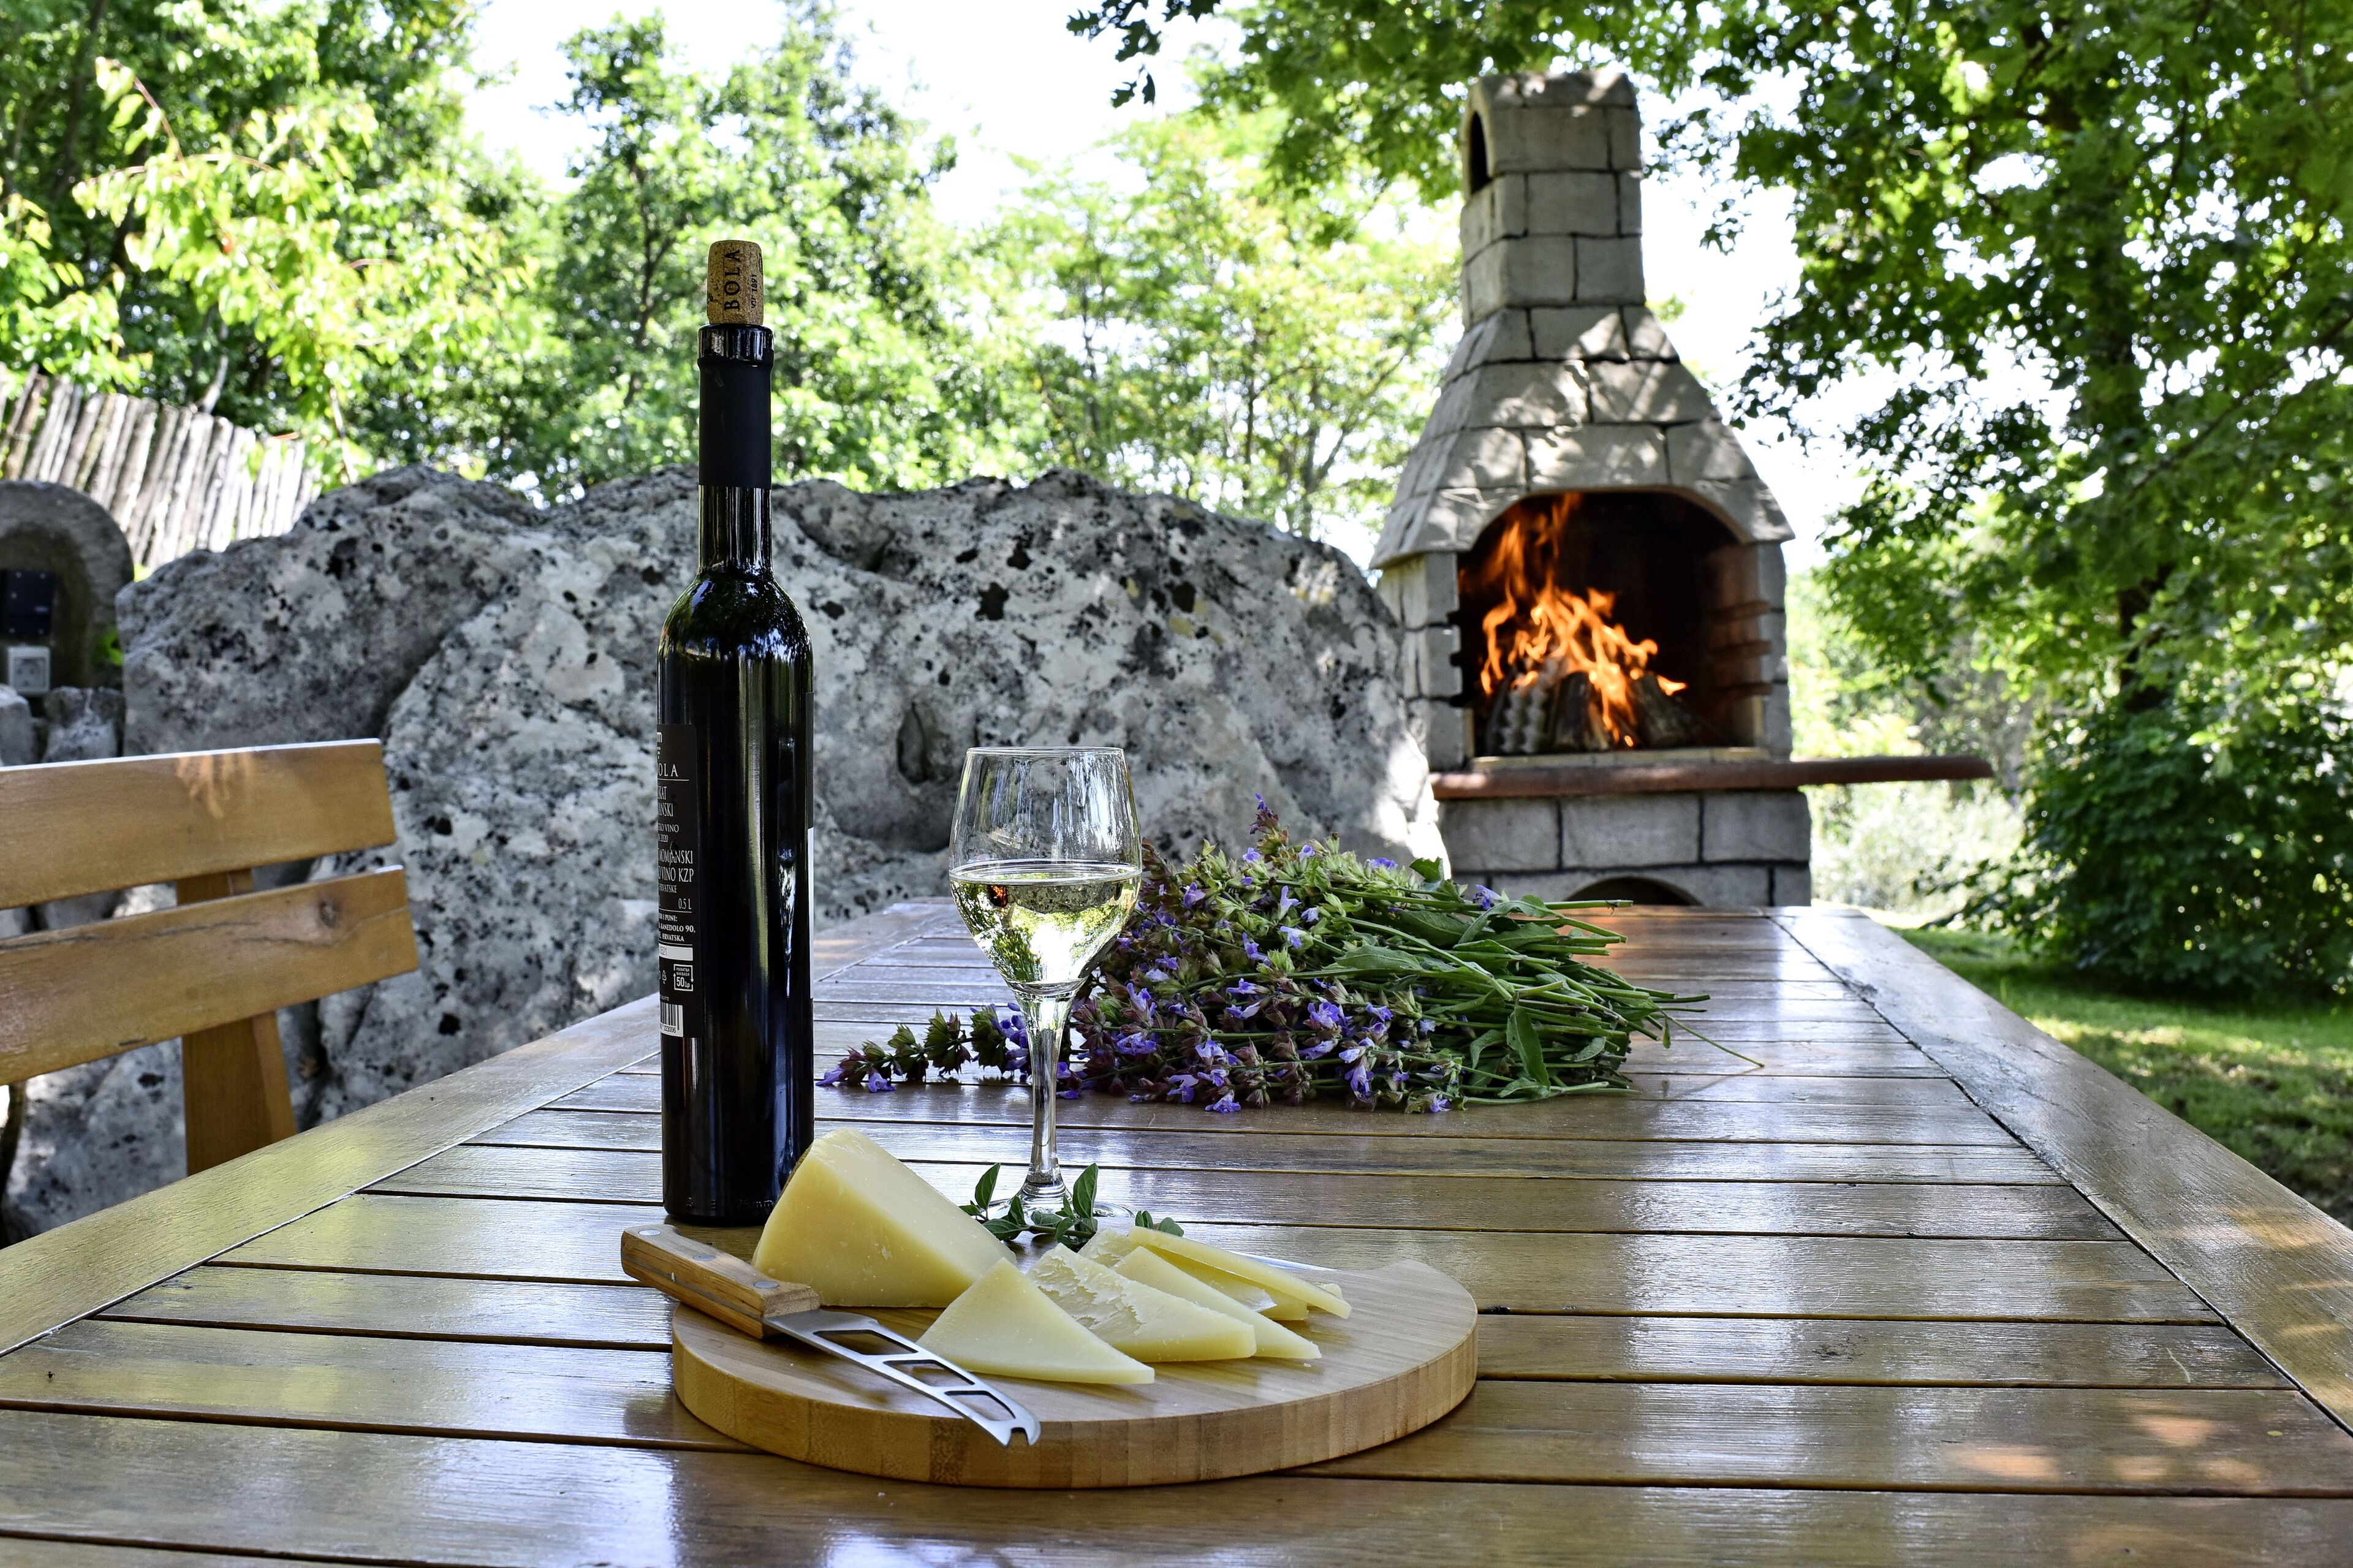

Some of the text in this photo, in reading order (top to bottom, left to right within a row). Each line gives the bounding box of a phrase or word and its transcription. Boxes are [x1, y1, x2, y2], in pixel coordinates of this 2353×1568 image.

[724, 249, 741, 311] BOLA
[658, 762, 679, 777] OLA
[664, 824, 680, 833] VINO
[678, 868, 694, 883] KZP
[685, 925, 696, 934] 90,
[662, 933, 684, 942] HRVATSKA
